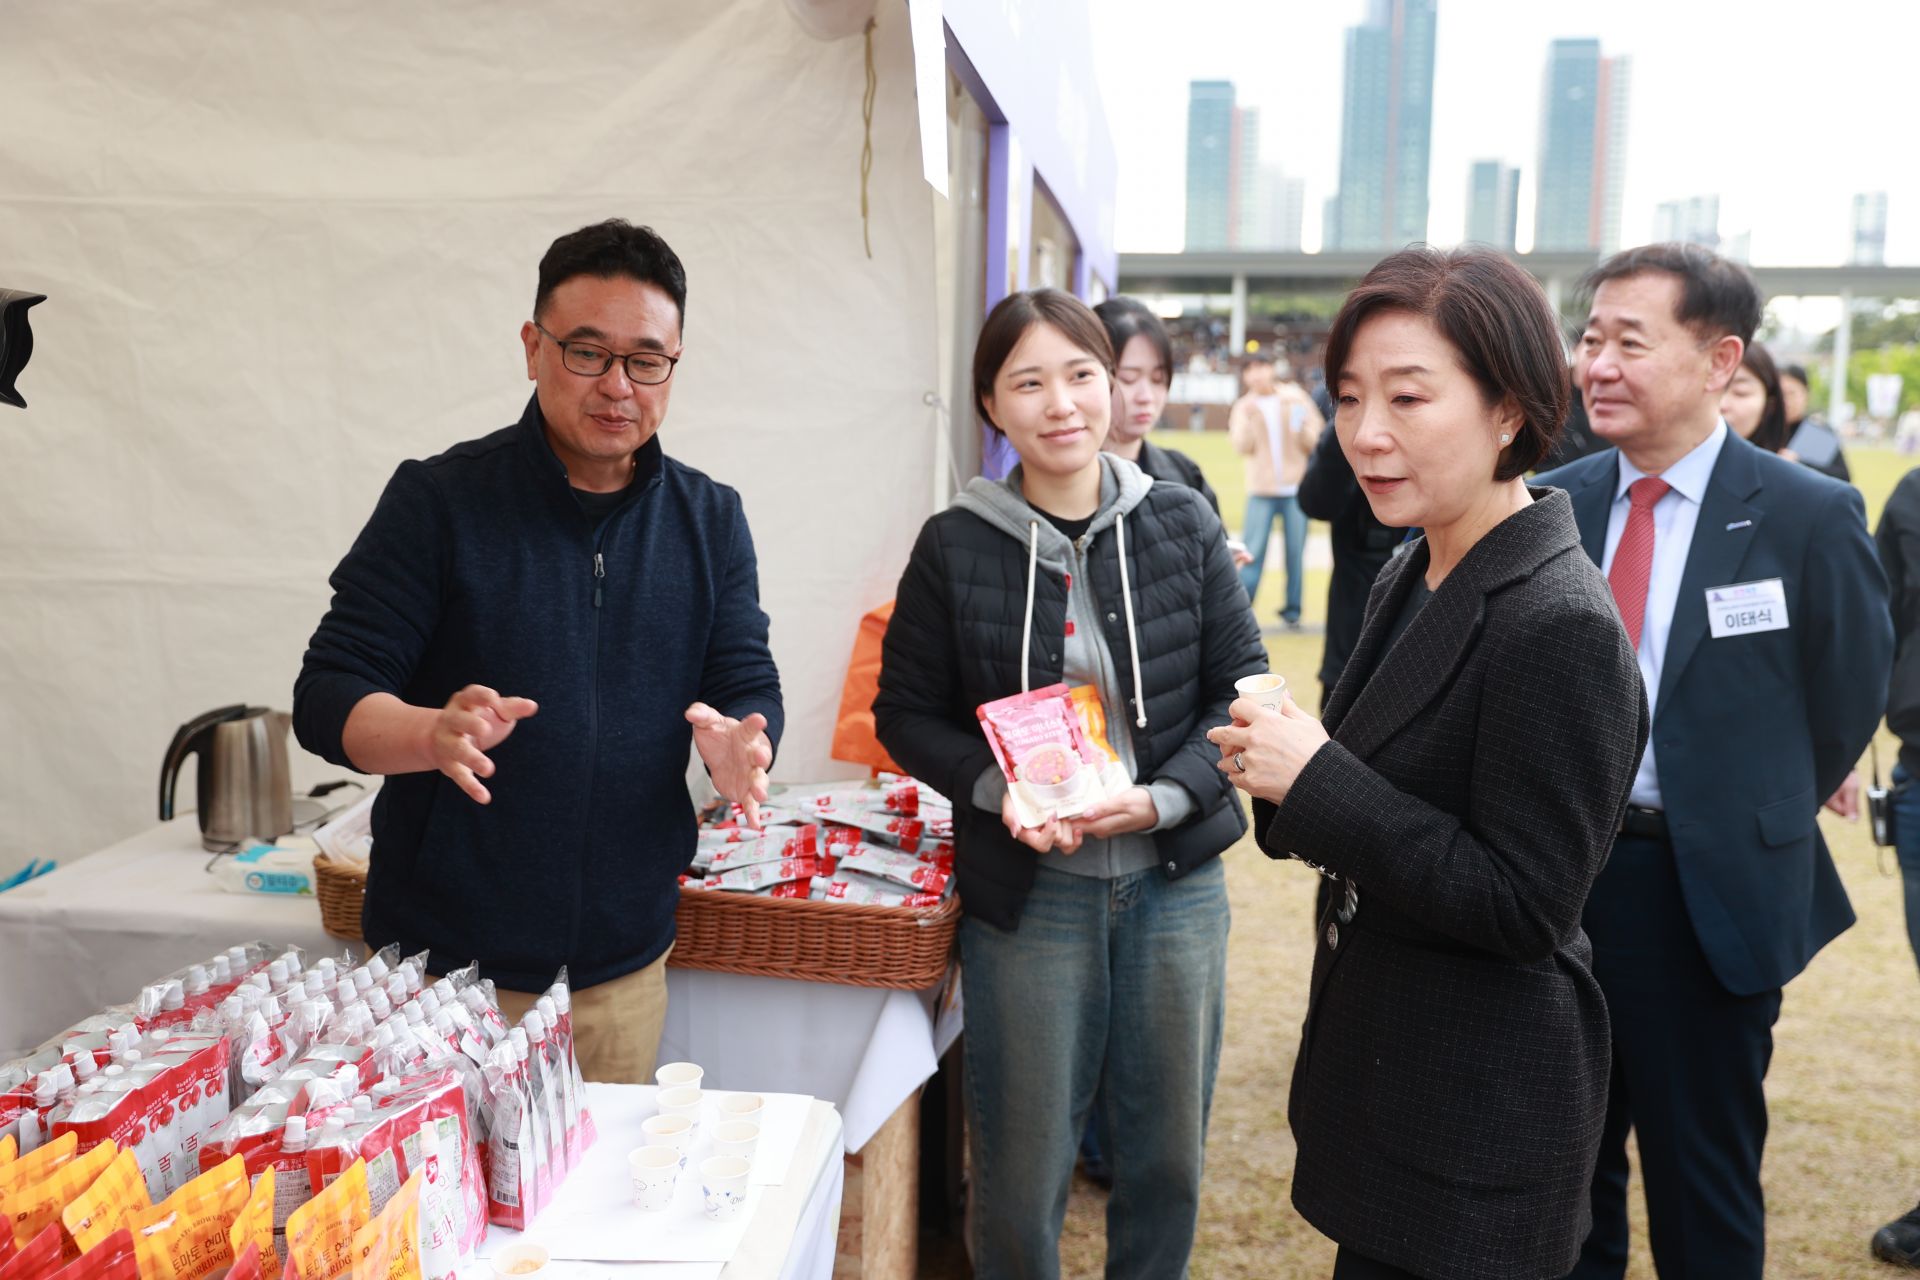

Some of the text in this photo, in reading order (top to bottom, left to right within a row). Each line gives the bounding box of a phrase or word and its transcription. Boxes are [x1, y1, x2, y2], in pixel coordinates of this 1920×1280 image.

[1725, 609, 1772, 629] 이태식
[172, 1245, 202, 1276] 토마토
[186, 1247, 231, 1280] PORRIDGE
[304, 1247, 333, 1280] 토마토
